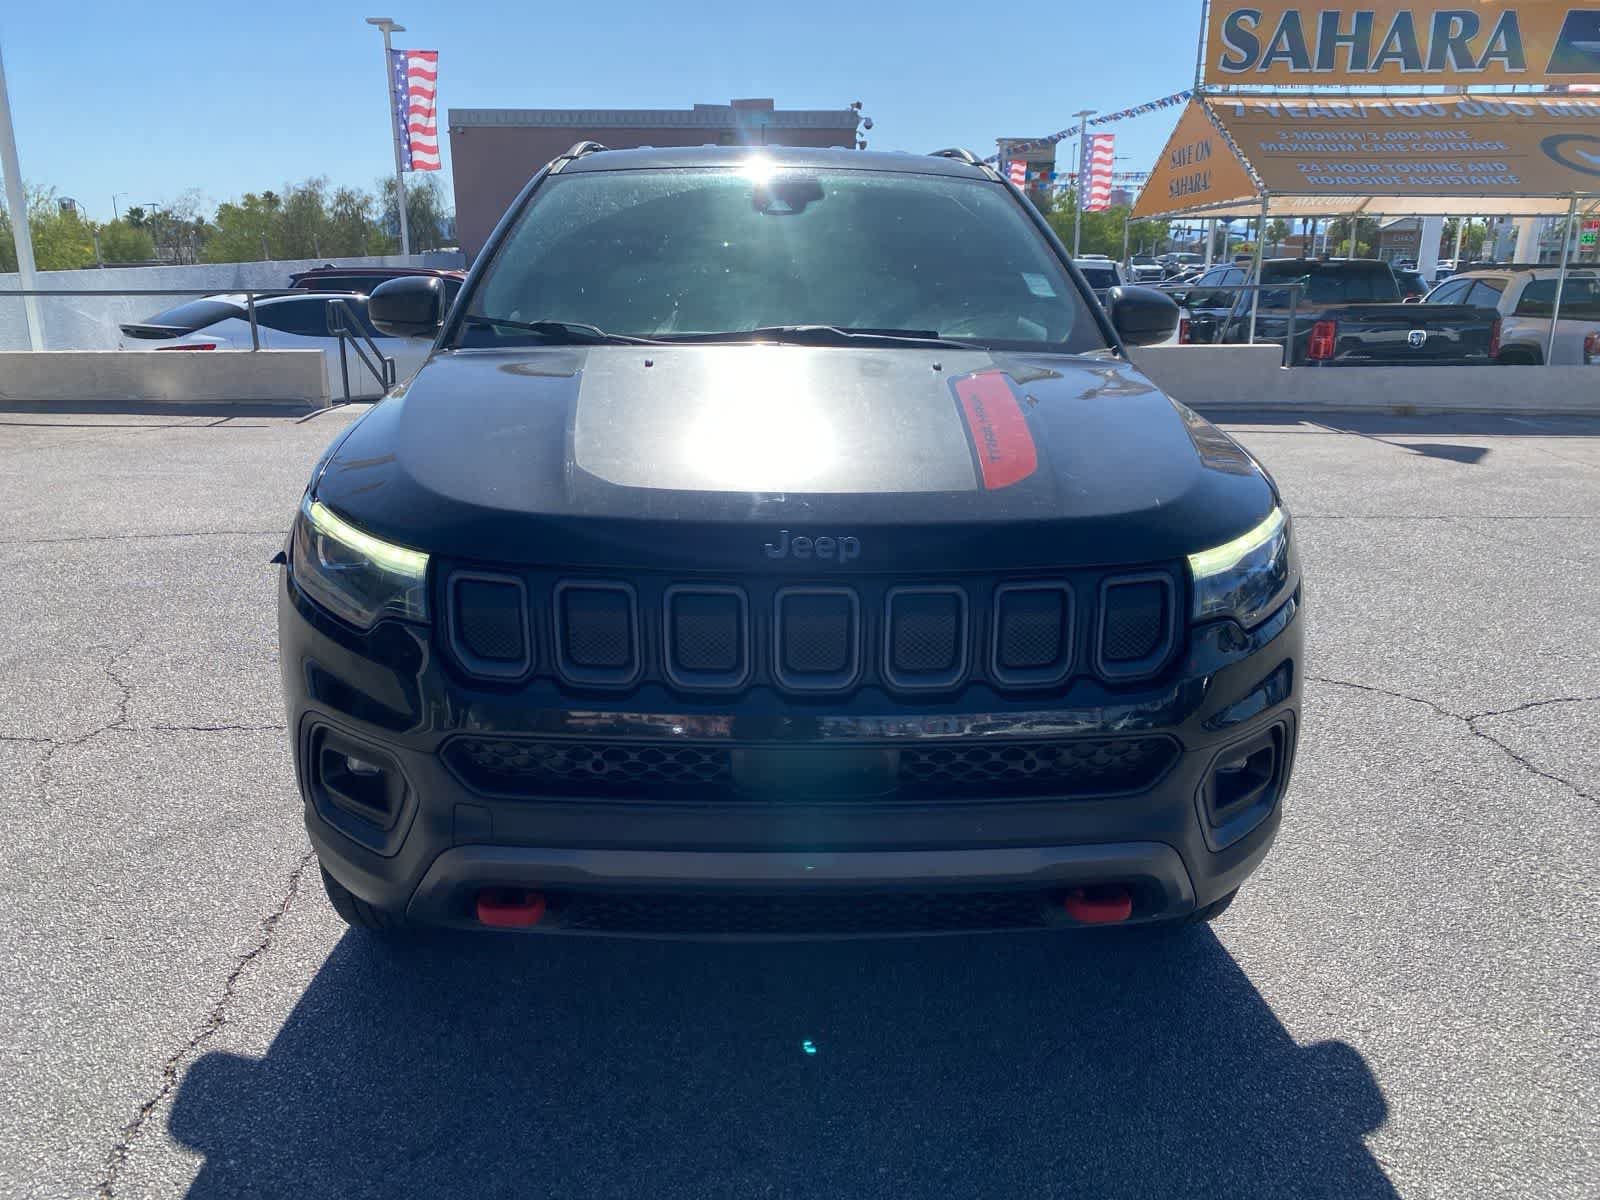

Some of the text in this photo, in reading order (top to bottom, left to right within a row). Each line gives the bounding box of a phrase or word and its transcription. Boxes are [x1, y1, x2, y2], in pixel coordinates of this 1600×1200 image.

[1218, 9, 1528, 73] SAHARA
[1169, 139, 1212, 169] SAVE ON
[1259, 141, 1509, 152] MAXIMUM CARE COVERAGE
[1384, 162, 1464, 173] TOWING
[1467, 162, 1509, 172] AND
[1305, 175, 1521, 185] ROADSIDE ASSISTANCE
[764, 529, 861, 564] Jeep
